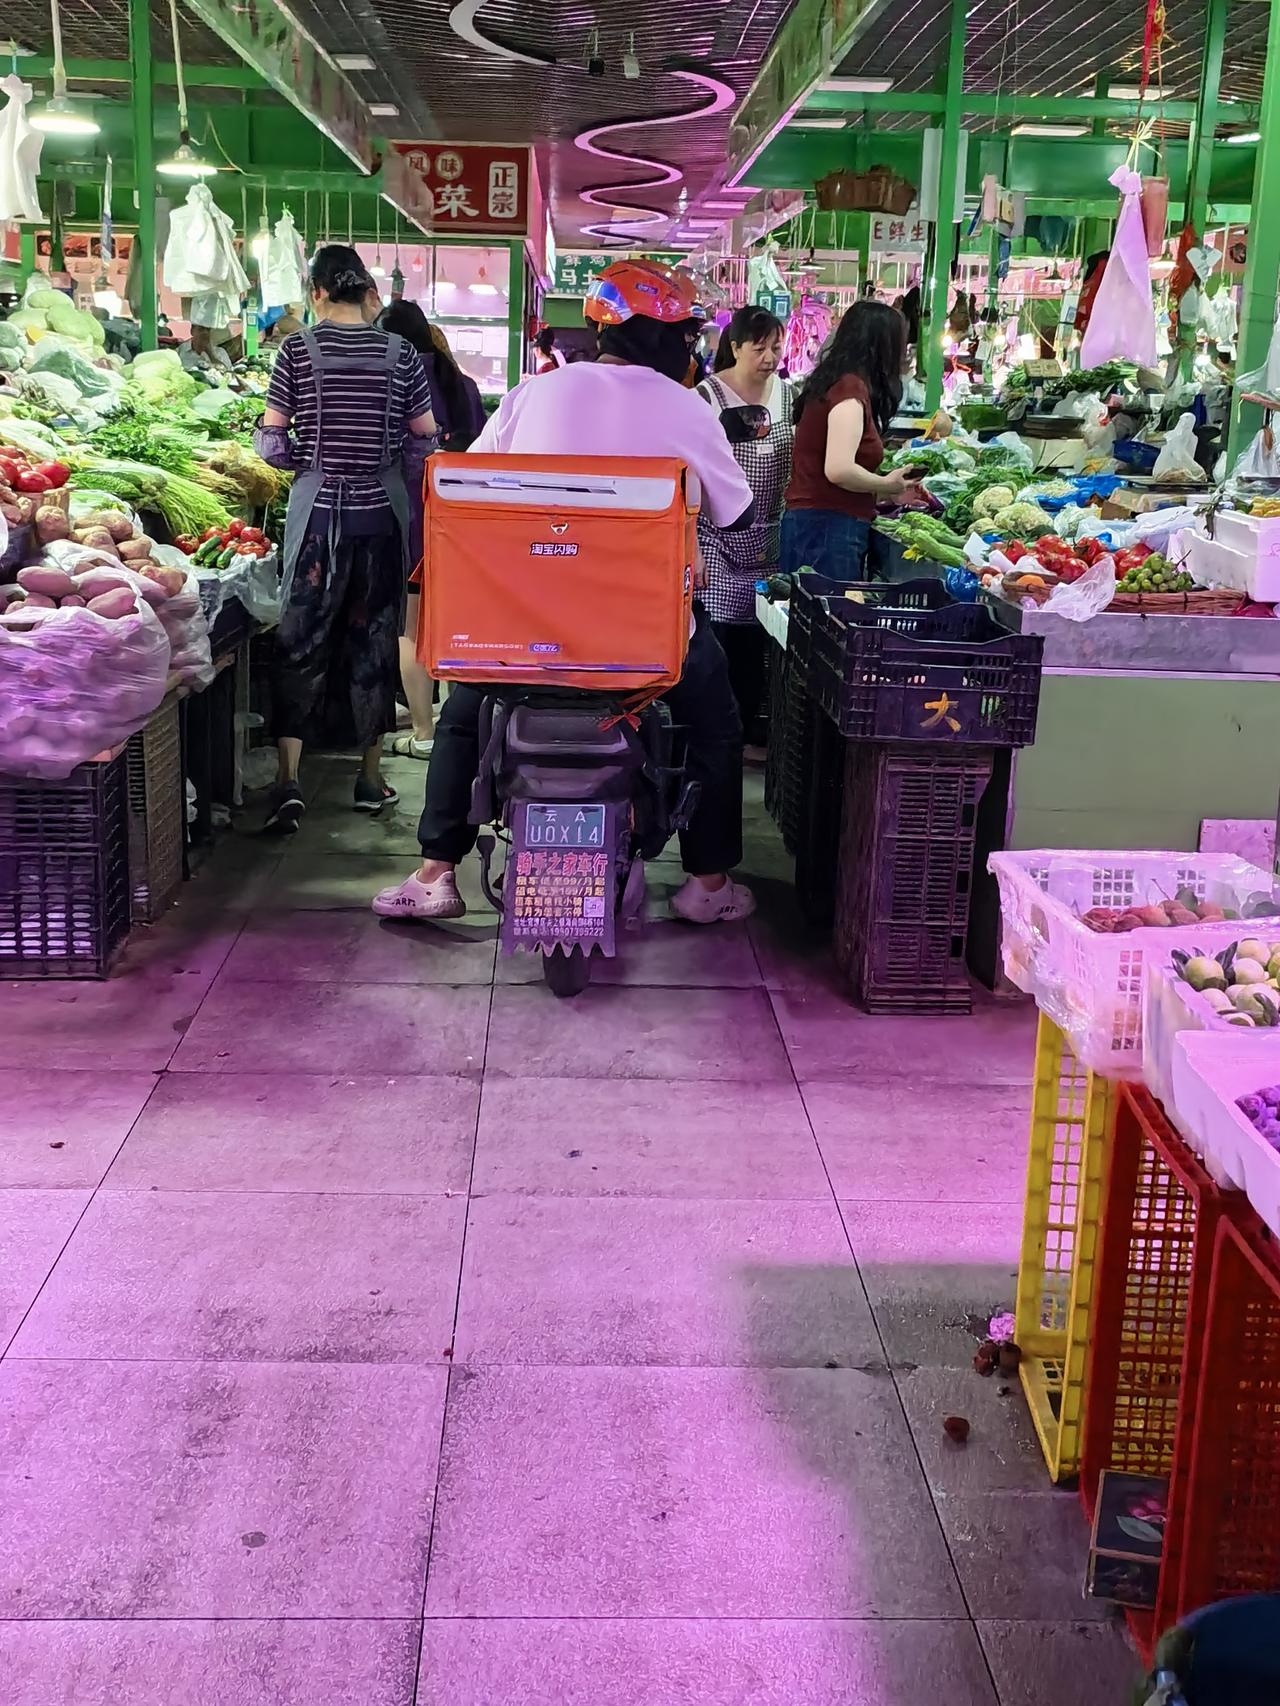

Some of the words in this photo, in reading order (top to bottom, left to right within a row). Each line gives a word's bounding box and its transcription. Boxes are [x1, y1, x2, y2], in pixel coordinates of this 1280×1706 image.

[432, 184, 480, 218] 菜
[492, 165, 514, 213] 正宗
[531, 543, 578, 555] 淘宝闪购
[920, 691, 962, 732] 大
